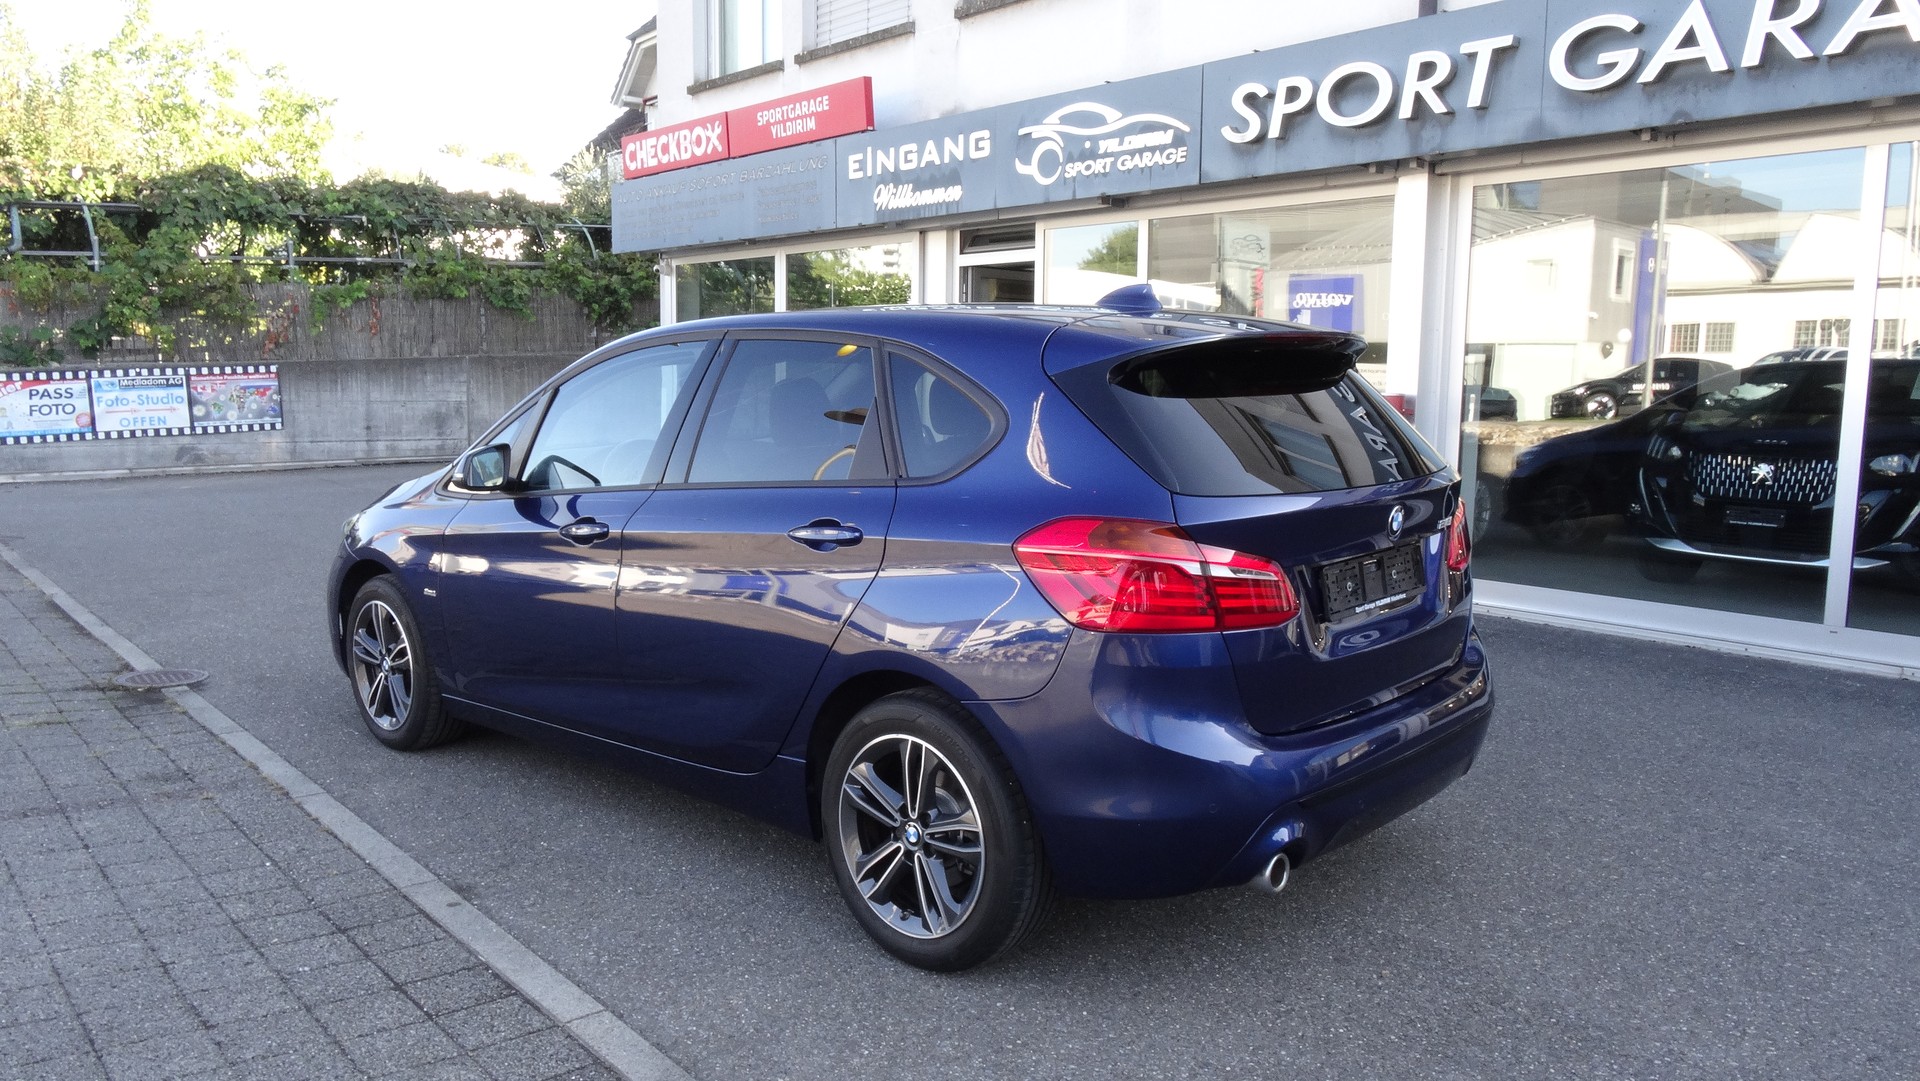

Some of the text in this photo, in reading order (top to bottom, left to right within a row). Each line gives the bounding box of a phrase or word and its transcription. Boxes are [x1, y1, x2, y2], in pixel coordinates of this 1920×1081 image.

[1221, 34, 1515, 145] SPORT
[756, 95, 830, 127] SPORTGARAGE
[770, 118, 816, 140] YILDIRIM
[624, 120, 723, 171] CHECKBOX
[848, 129, 992, 180] EINGANG
[1064, 147, 1188, 179] SPORT GARAGE
[872, 183, 963, 212] Willkommen
[29, 387, 74, 400] PASS
[119, 378, 167, 387] Mediadom
[168, 377, 183, 385] AG
[29, 403, 76, 417] FOTO
[96, 393, 185, 407] Foto-Studio
[119, 416, 167, 428] OFFEN
